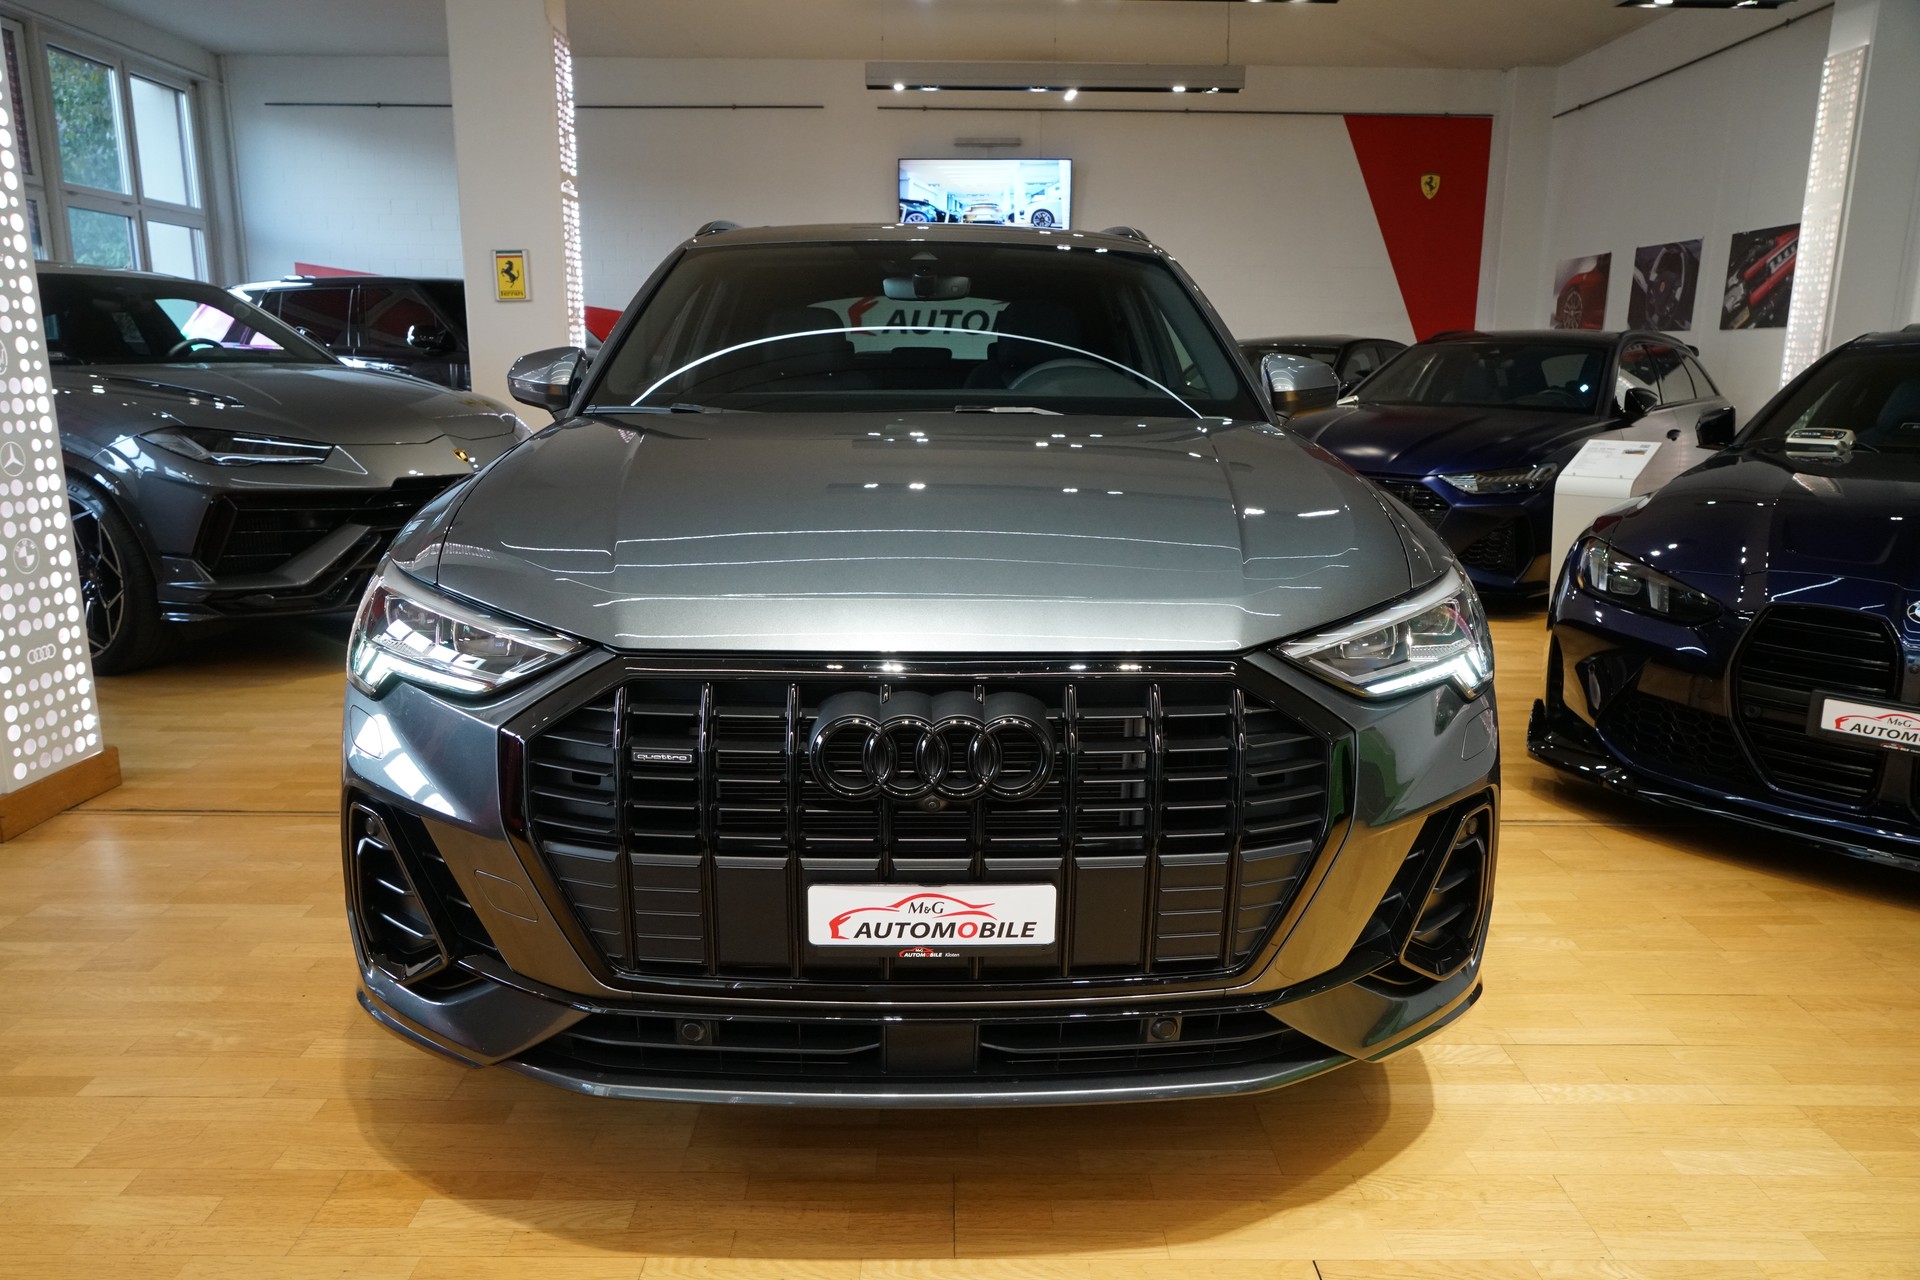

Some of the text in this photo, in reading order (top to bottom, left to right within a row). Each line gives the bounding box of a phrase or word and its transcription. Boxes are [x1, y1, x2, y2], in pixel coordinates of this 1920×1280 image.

[881, 309, 1000, 335] AUTO
[1887, 717, 1913, 728] M&G
[1850, 723, 1920, 743] AUTOM
[907, 901, 945, 915] M&G
[853, 921, 1037, 939] AUTOMOBILE
